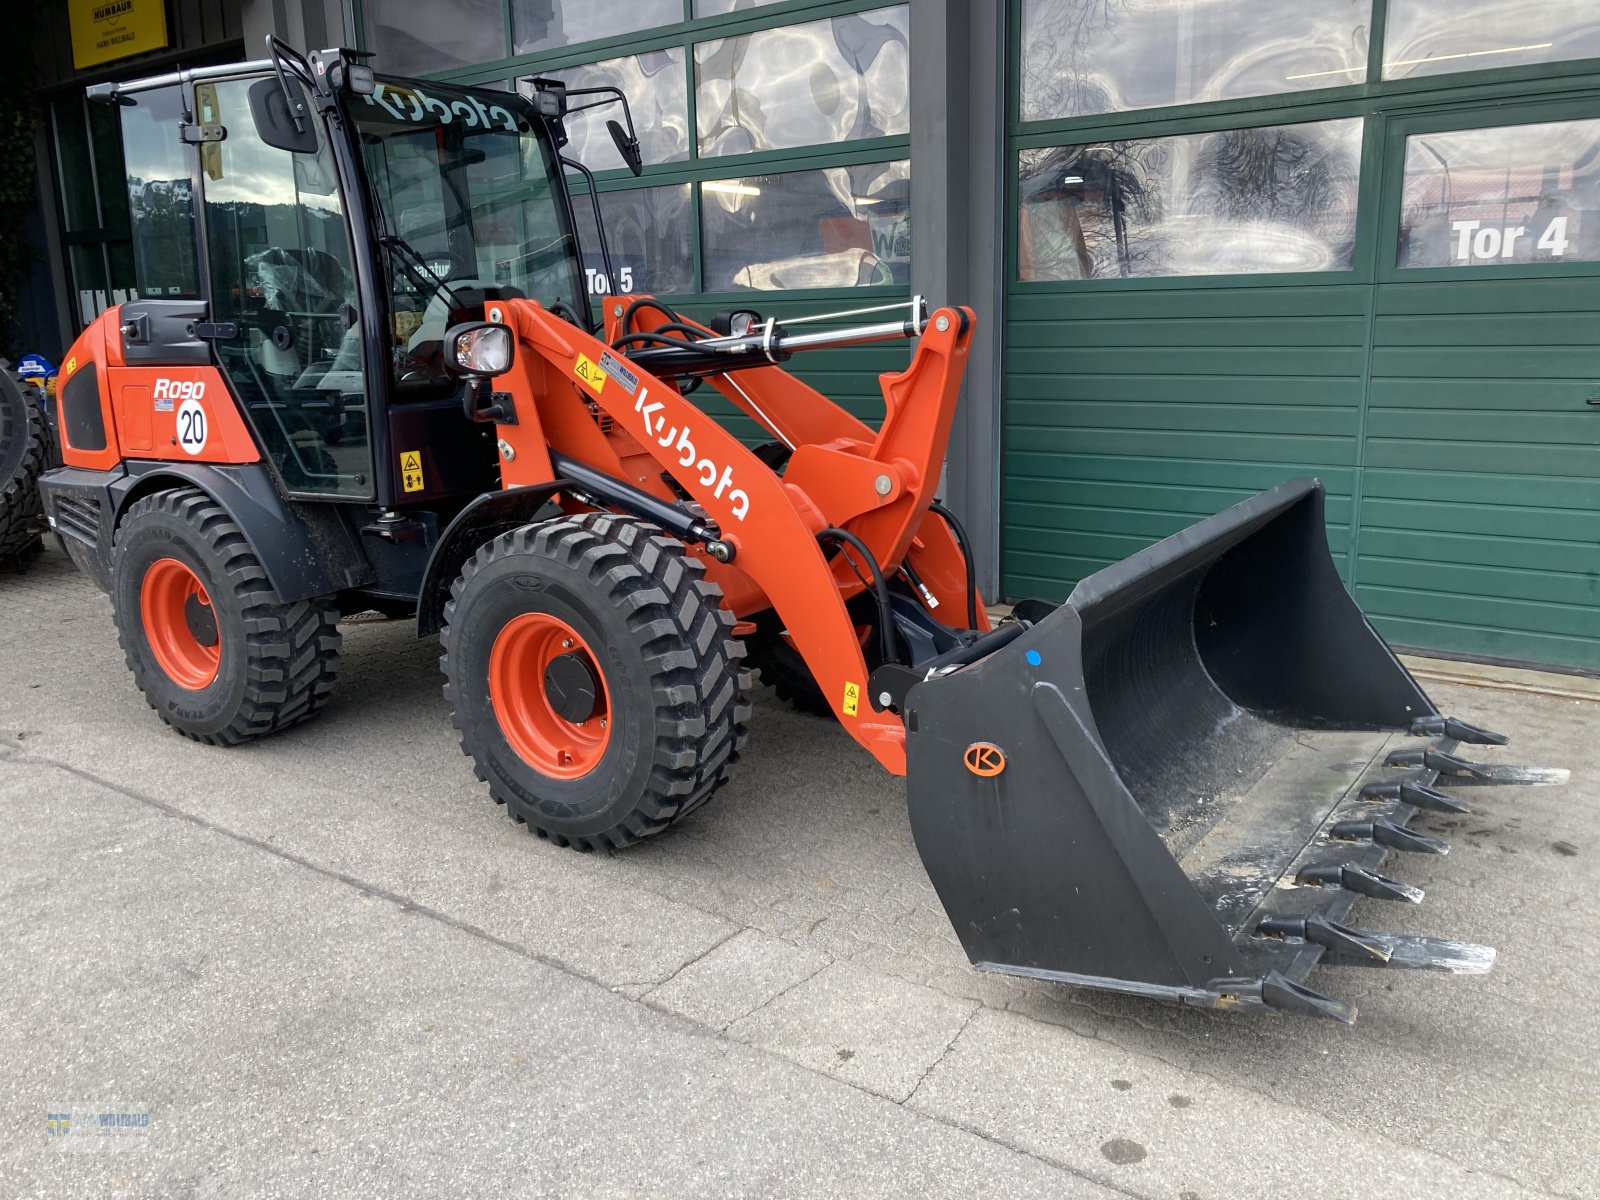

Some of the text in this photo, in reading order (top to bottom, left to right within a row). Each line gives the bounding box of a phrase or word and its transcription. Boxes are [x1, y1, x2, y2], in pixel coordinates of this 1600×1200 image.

[94, 0, 132, 20] HUMBAUR
[362, 84, 518, 132] Kubota
[1452, 216, 1569, 259] Tor 4
[620, 266, 633, 293] 5
[181, 409, 204, 445] 20
[634, 387, 750, 522] Kubota
